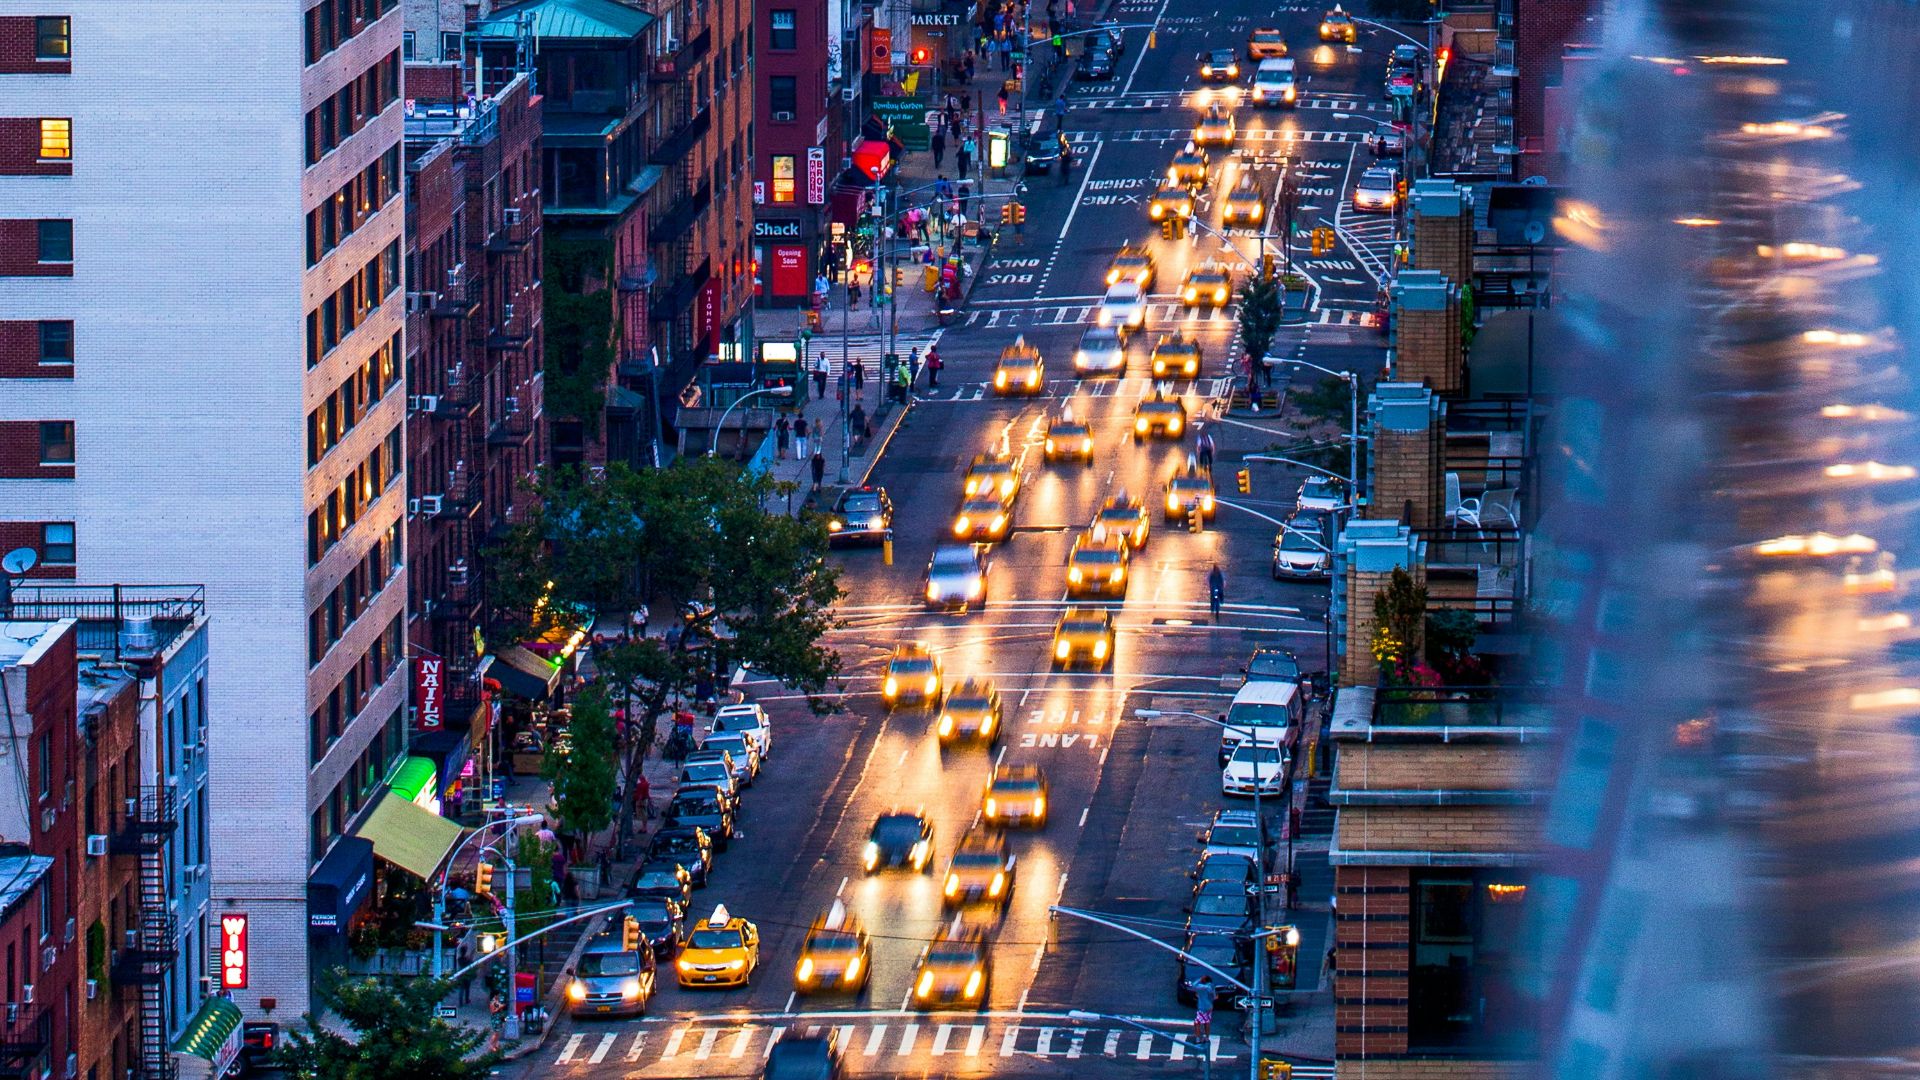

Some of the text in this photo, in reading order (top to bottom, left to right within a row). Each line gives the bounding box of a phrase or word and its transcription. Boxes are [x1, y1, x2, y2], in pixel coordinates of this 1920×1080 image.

[873, 101, 923, 111] Bombay Garden
[755, 222, 799, 236] Shack
[777, 249, 802, 257] Opening
[987, 259, 1040, 269] ONLY
[1304, 260, 1356, 270] ONLY
[986, 274, 1034, 284] BUS
[421, 660, 441, 726] NAILS
[1027, 710, 1106, 724] FIRE
[1019, 733, 1099, 749] LANE
[223, 918, 245, 985] WINE
